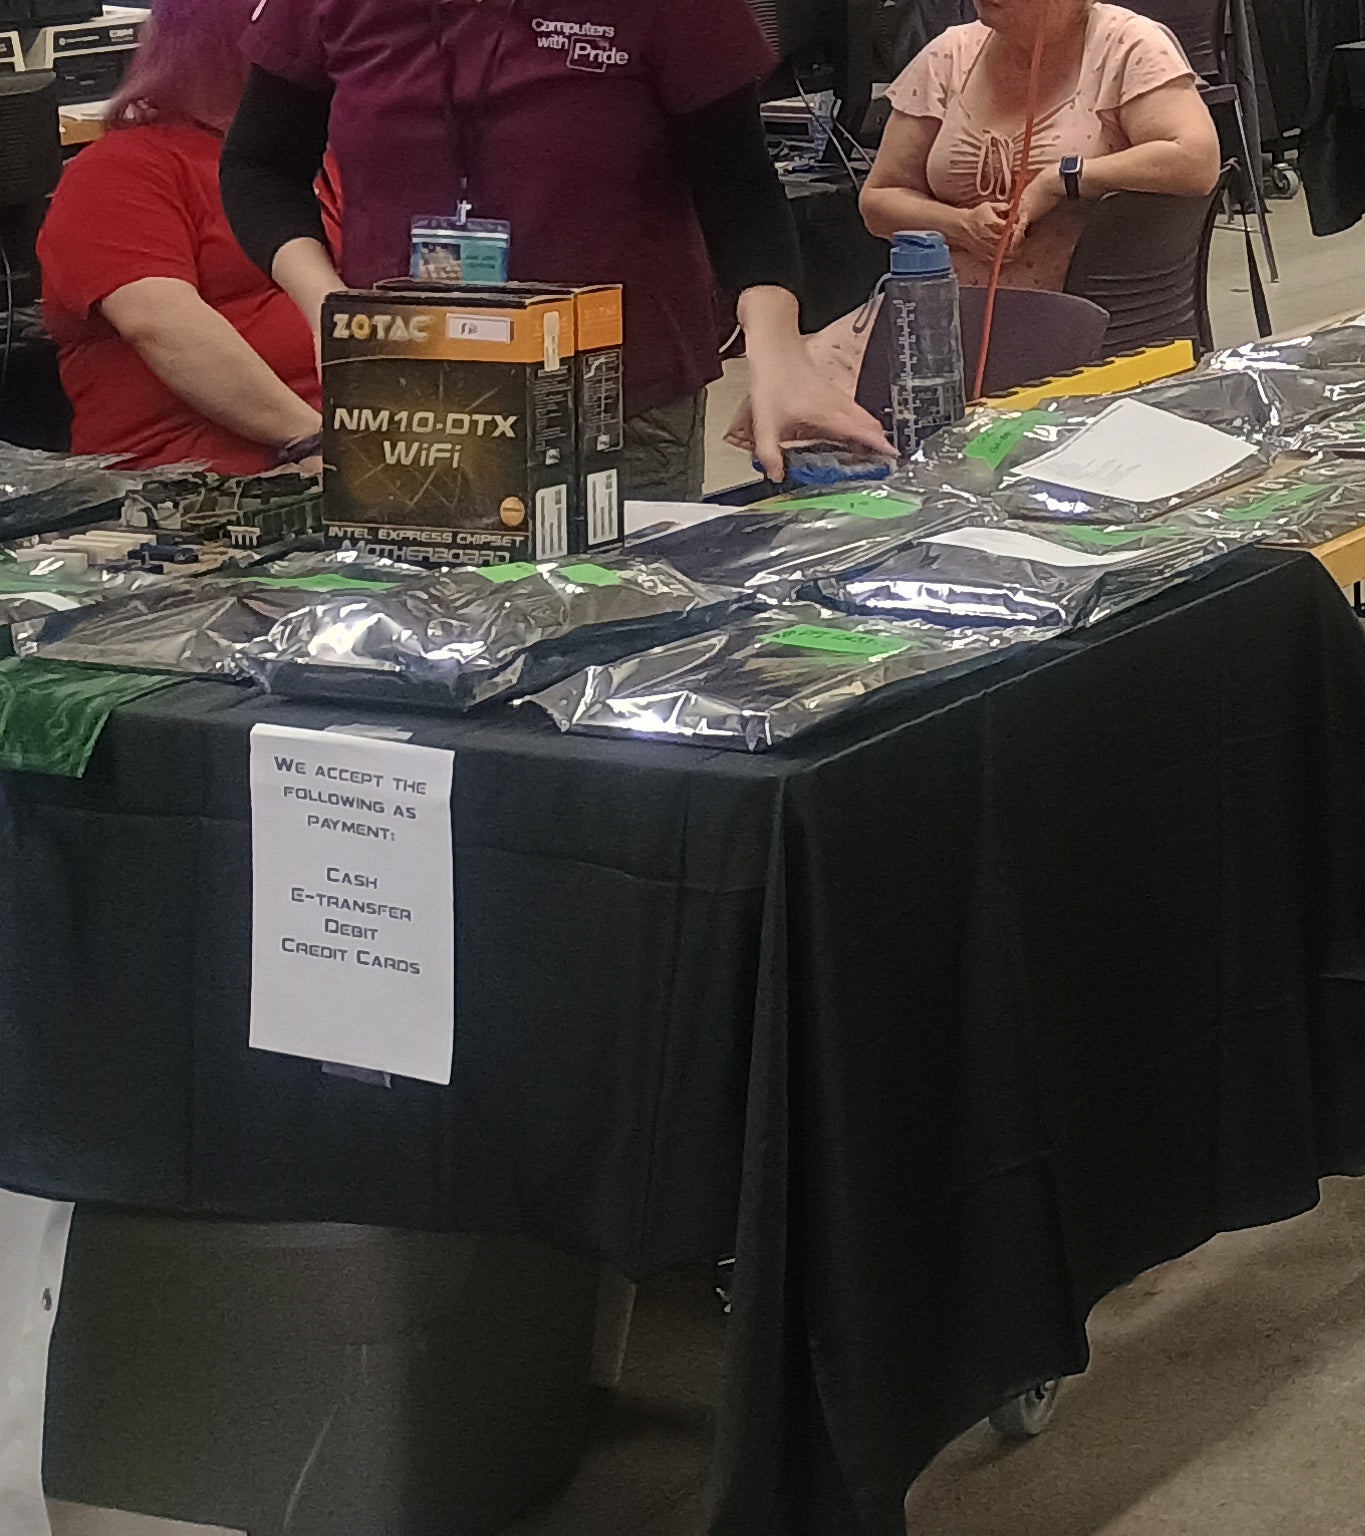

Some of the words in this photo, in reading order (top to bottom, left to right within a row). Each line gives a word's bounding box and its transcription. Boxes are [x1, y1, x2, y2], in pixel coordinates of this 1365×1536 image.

[531, 18, 615, 38] Computers
[537, 34, 569, 50] with
[573, 43, 629, 65] Pride
[332, 313, 431, 342] ZOTAC
[333, 407, 519, 439] NM10-DTX
[382, 439, 463, 469] WiFi
[328, 526, 373, 540] INTEL
[378, 528, 453, 544] EXPRESS
[456, 532, 526, 548] CHIPSET
[340, 539, 511, 565] MOTHERBOARD
[273, 755, 307, 776] WE
[314, 764, 385, 788] ACCEPT
[392, 776, 428, 796] THE
[283, 785, 386, 814] FOLLOWING
[392, 804, 417, 820] AS
[307, 814, 396, 842] PAYMENT:
[326, 867, 379, 890] CASH
[290, 887, 412, 923] E-TRANSFER
[324, 918, 379, 941] DEBIT
[280, 936, 349, 963] CREDIT
[356, 949, 421, 975] CARDS
